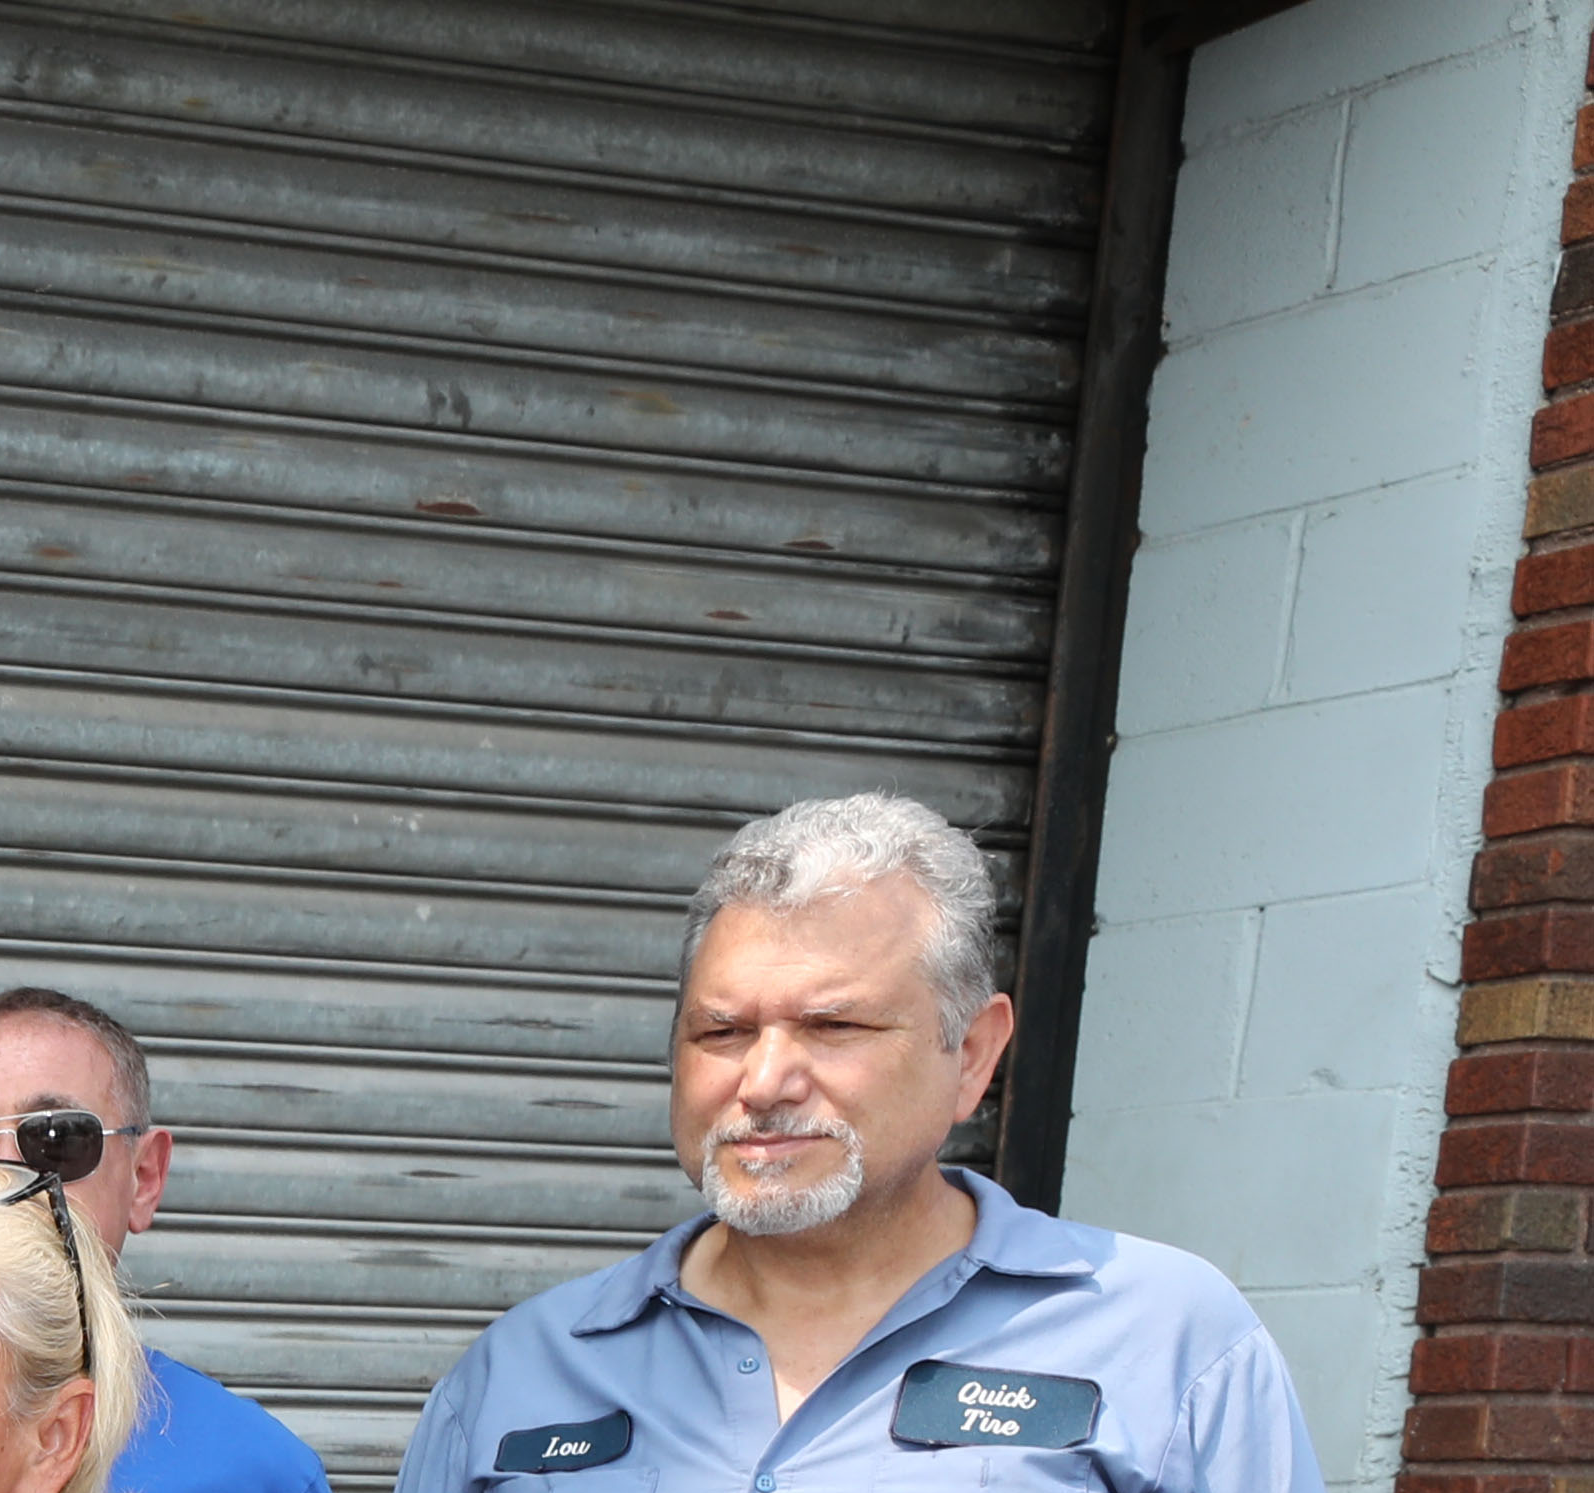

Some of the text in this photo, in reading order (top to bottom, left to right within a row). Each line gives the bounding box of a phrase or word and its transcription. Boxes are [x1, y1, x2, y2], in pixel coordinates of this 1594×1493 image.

[957, 1381, 1037, 1410] Quick
[960, 1408, 1021, 1437] Tire
[541, 1436, 592, 1458] Lou
